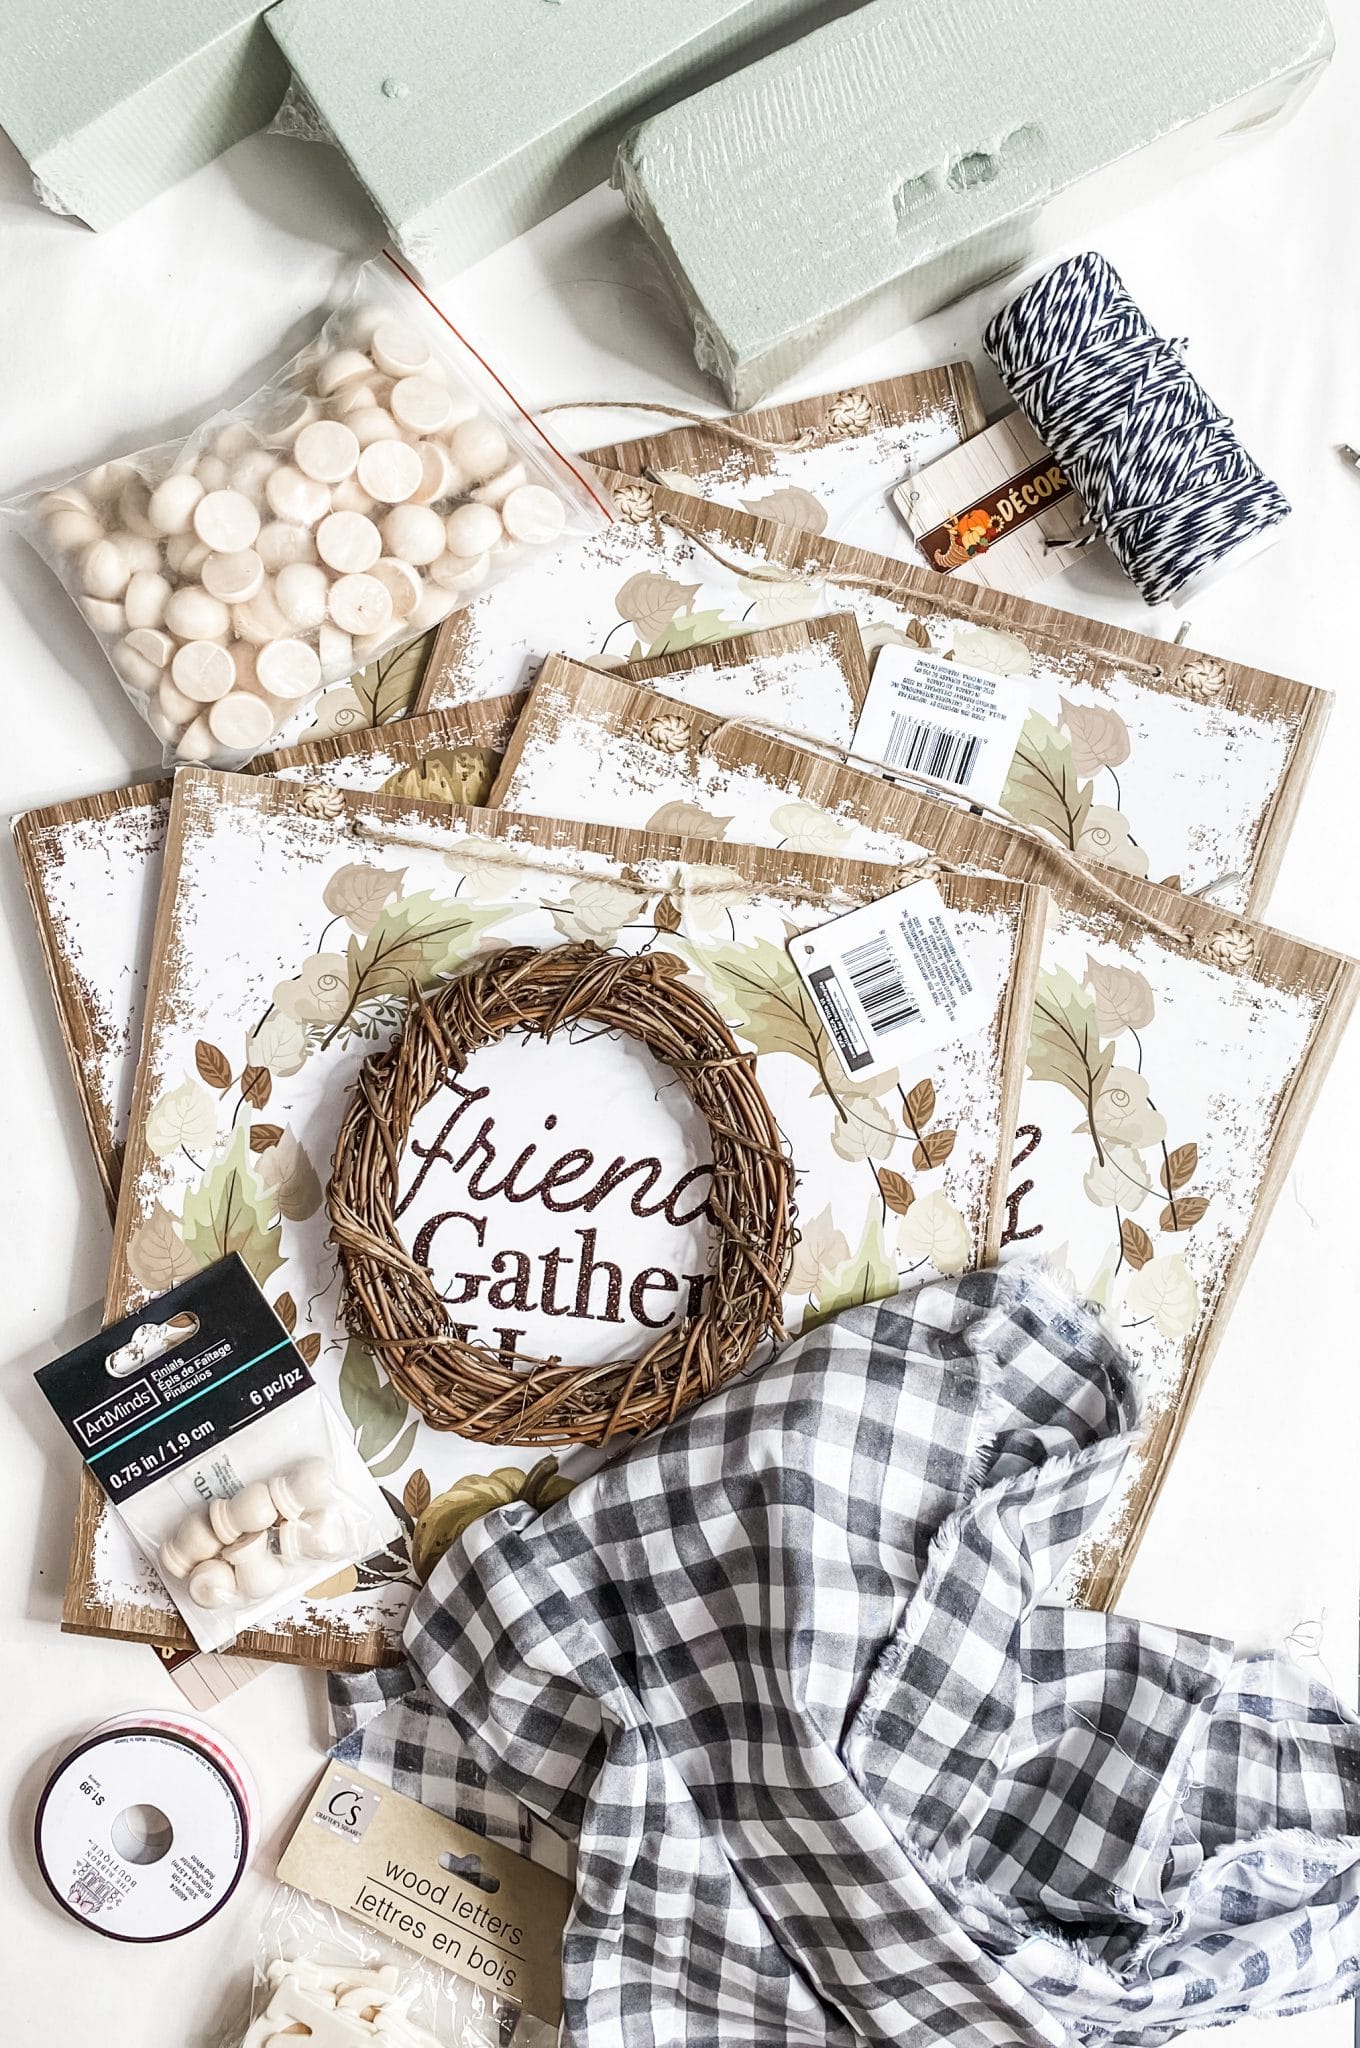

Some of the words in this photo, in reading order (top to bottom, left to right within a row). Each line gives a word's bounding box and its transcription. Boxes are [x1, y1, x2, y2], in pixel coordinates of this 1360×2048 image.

[996, 466, 1067, 522] DÉCOR
[955, 686, 974, 696] CANADA
[412, 1211, 720, 1328] Gather
[151, 1358, 184, 1381] Finials
[157, 1374, 180, 1391] Épis
[181, 1366, 194, 1377] de
[194, 1344, 232, 1369] Faîtage
[164, 1370, 212, 1401] Pináculos
[250, 1391, 262, 1405] 6
[263, 1368, 303, 1401] pc/pz
[85, 1391, 150, 1438] ArtMinds
[110, 1462, 142, 1488] 0.75
[140, 1455, 158, 1470] in
[166, 1433, 190, 1453] 1.9
[191, 1421, 214, 1440] cm
[79, 1781, 105, 1806] $1.99
[315, 1811, 340, 1827] CRAFTER'S
[85, 1850, 115, 1878] RIBBON
[115, 1878, 130, 1894] THE
[386, 1861, 449, 1905] wood
[452, 1893, 527, 1945] letters
[356, 1886, 426, 1938] lettres
[432, 1933, 461, 1958] en
[467, 1946, 521, 1988] bois
